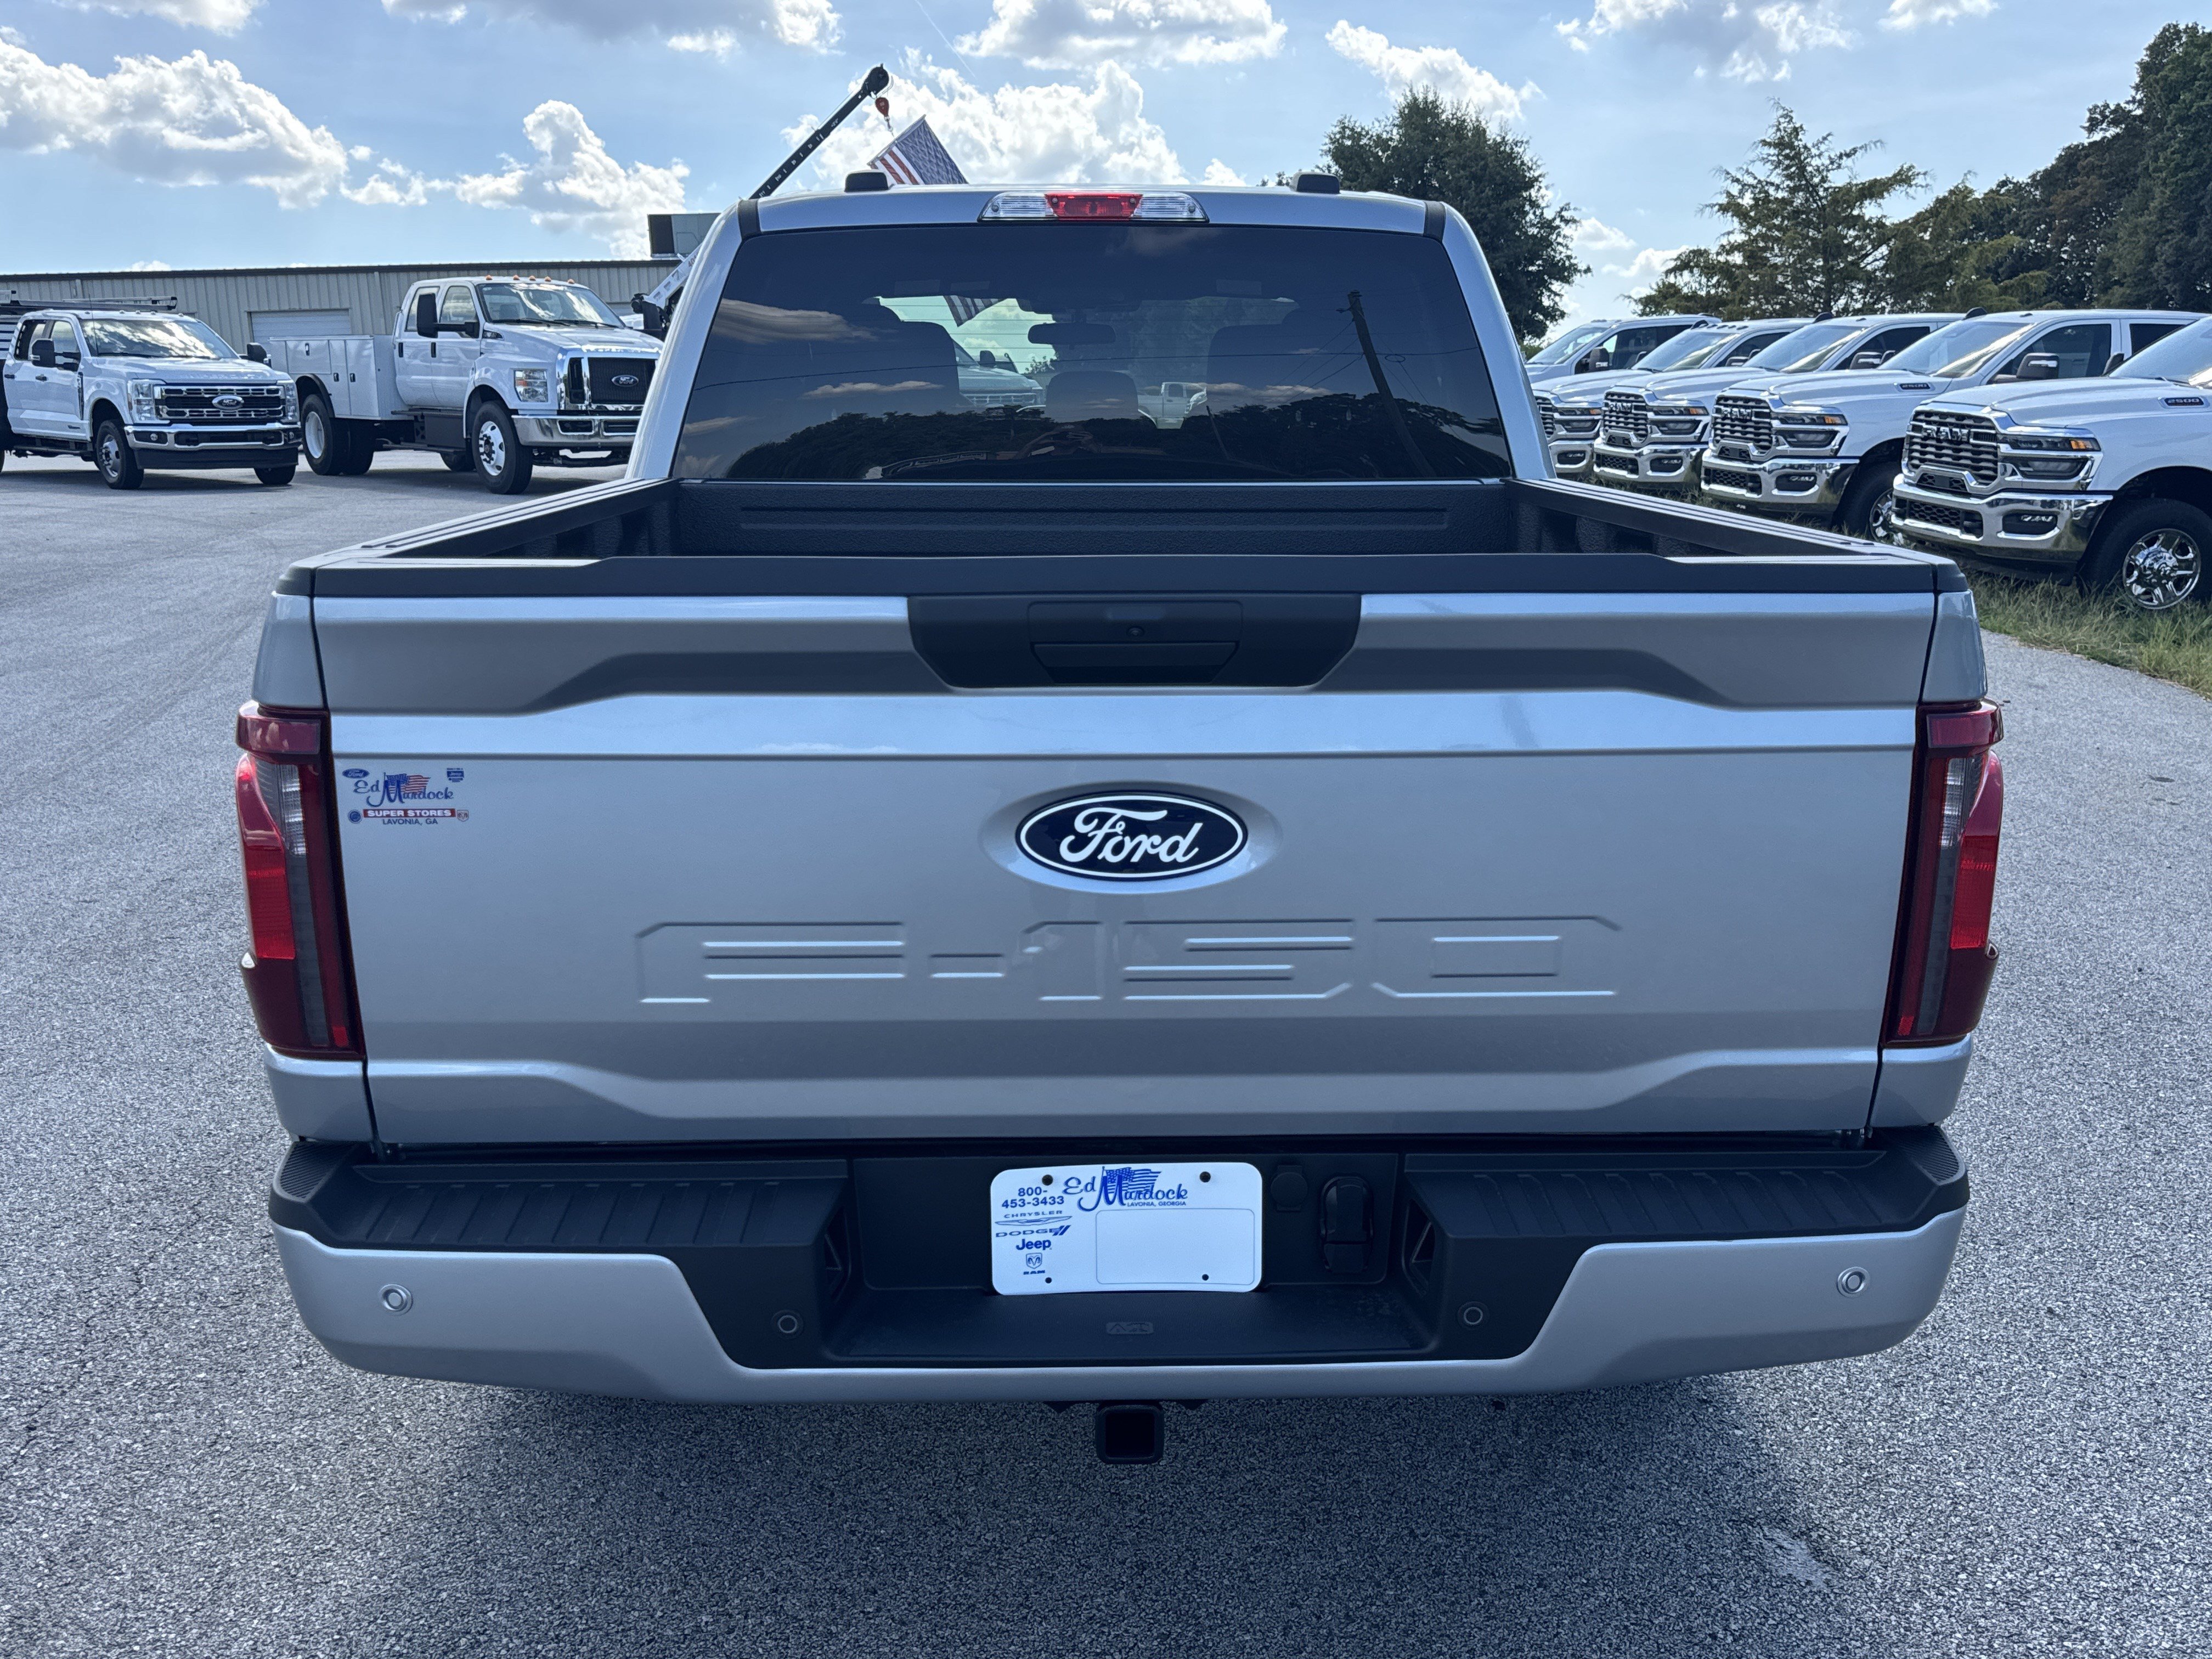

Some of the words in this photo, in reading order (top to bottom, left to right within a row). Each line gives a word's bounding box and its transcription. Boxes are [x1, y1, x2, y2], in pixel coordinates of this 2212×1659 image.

[1922, 425, 1969, 442] RAM
[353, 780, 381, 793] Ed
[366, 780, 454, 807] Murdock
[1059, 807, 1203, 863] Ford
[635, 916, 1622, 1003] F-150
[1018, 1186, 1048, 1197] 800-
[1062, 1176, 1097, 1195] Ed
[1077, 1175, 1188, 1211] Murdock
[1002, 1195, 1064, 1209] 453-3433
[1004, 1210, 1063, 1218] CHRYSLER
[995, 1228, 1062, 1237] DODGE
[1016, 1238, 1052, 1250] Jeep
